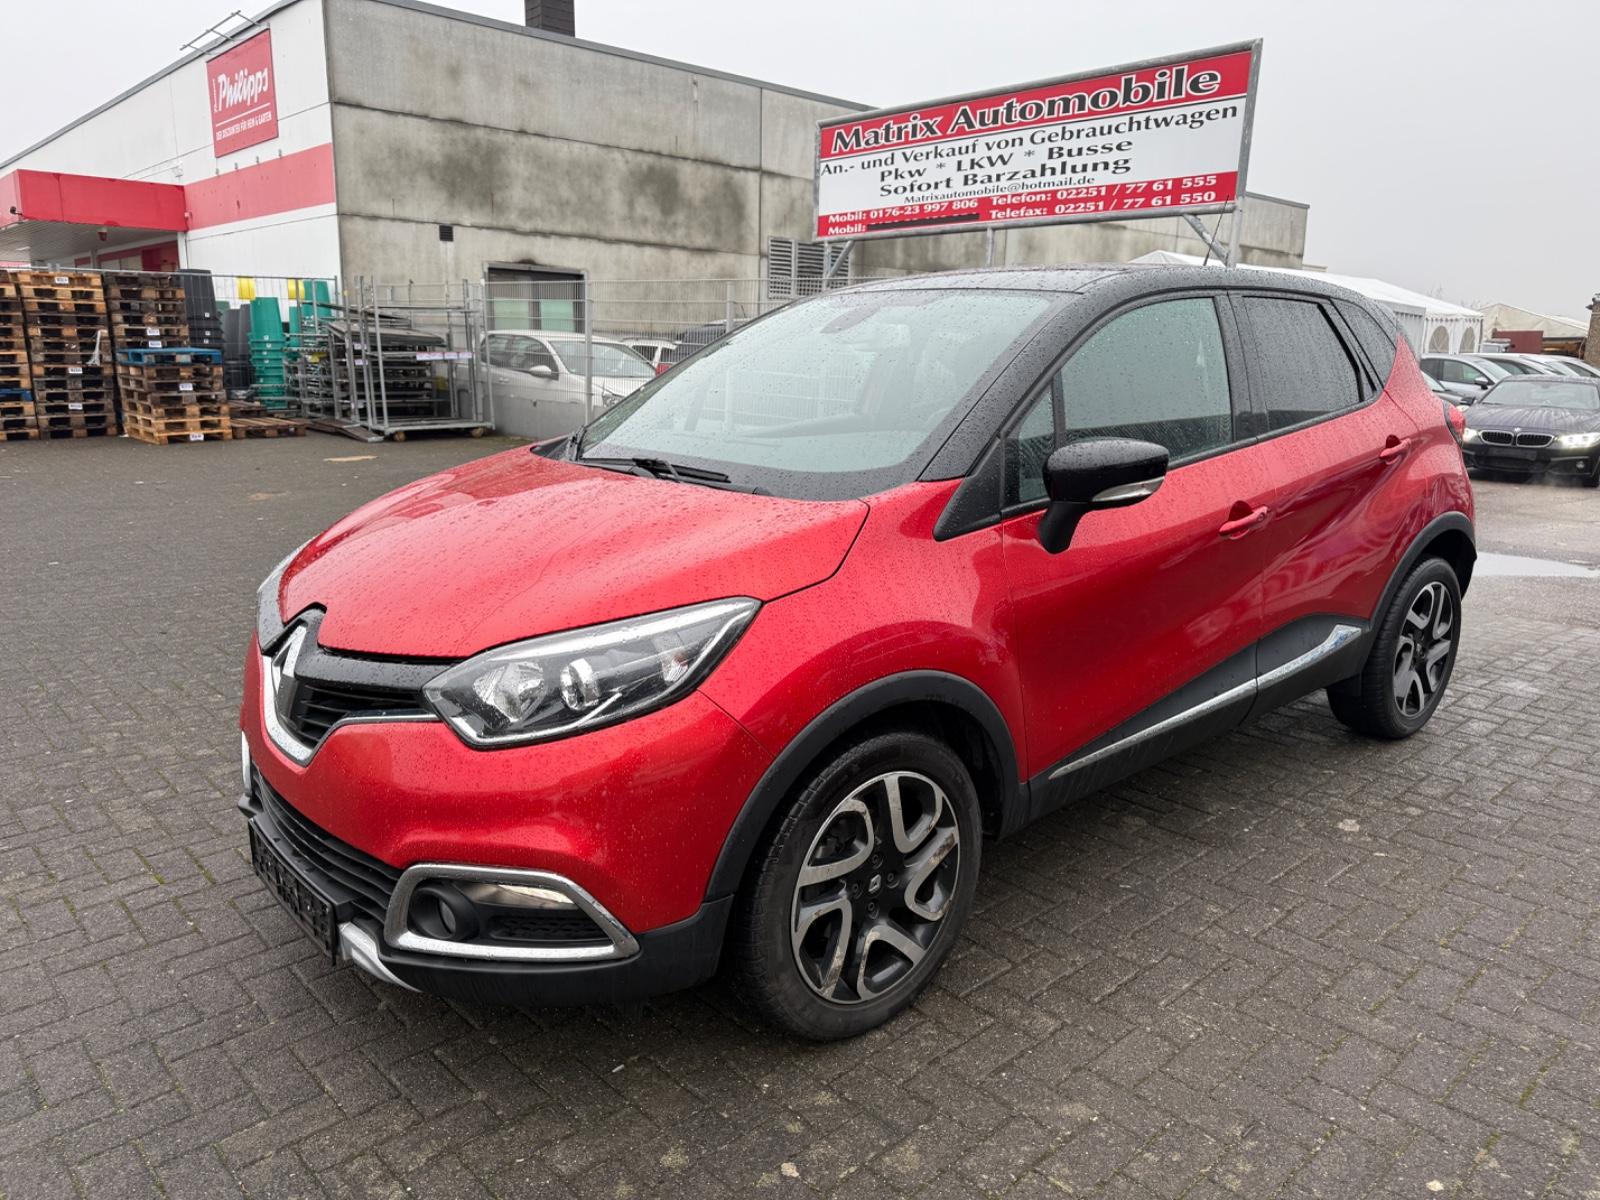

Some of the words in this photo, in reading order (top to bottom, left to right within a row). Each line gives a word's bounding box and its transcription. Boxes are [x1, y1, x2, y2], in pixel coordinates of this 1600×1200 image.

[217, 67, 268, 111] Philipps
[831, 113, 943, 154] Matrix
[946, 65, 1221, 134] Automobile
[821, 163, 855, 176] An.-
[861, 152, 895, 170] und
[902, 139, 979, 163] Verkauf
[985, 137, 1023, 152] von
[1030, 105, 1237, 145] Gebrauchtwagen
[880, 168, 927, 182] Pkw
[956, 153, 1014, 172] LKW
[1048, 140, 1133, 160] Busse
[880, 176, 952, 197] Sofort
[963, 158, 1132, 186] Barzahlung
[904, 176, 1095, 204] Matrixautomobile@hotmail.de
[989, 206, 1048, 219] Telefax:
[1054, 201, 1105, 214] 02251
[1109, 199, 1117, 210] /
[1123, 198, 1145, 208] 77
[1151, 195, 1172, 206] 61
[1179, 191, 1216, 204] 550
[990, 192, 1051, 206] Telefon:
[1056, 186, 1107, 200] 02251
[1112, 185, 1120, 196] /
[1125, 183, 1148, 194] 77
[1152, 180, 1173, 191] 61
[1181, 175, 1217, 188] 555
[828, 212, 866, 224] Mobil:
[869, 205, 920, 219] 0176-23
[923, 201, 949, 213] 997
[952, 198, 979, 209] 806
[827, 224, 866, 235] Mobil:
